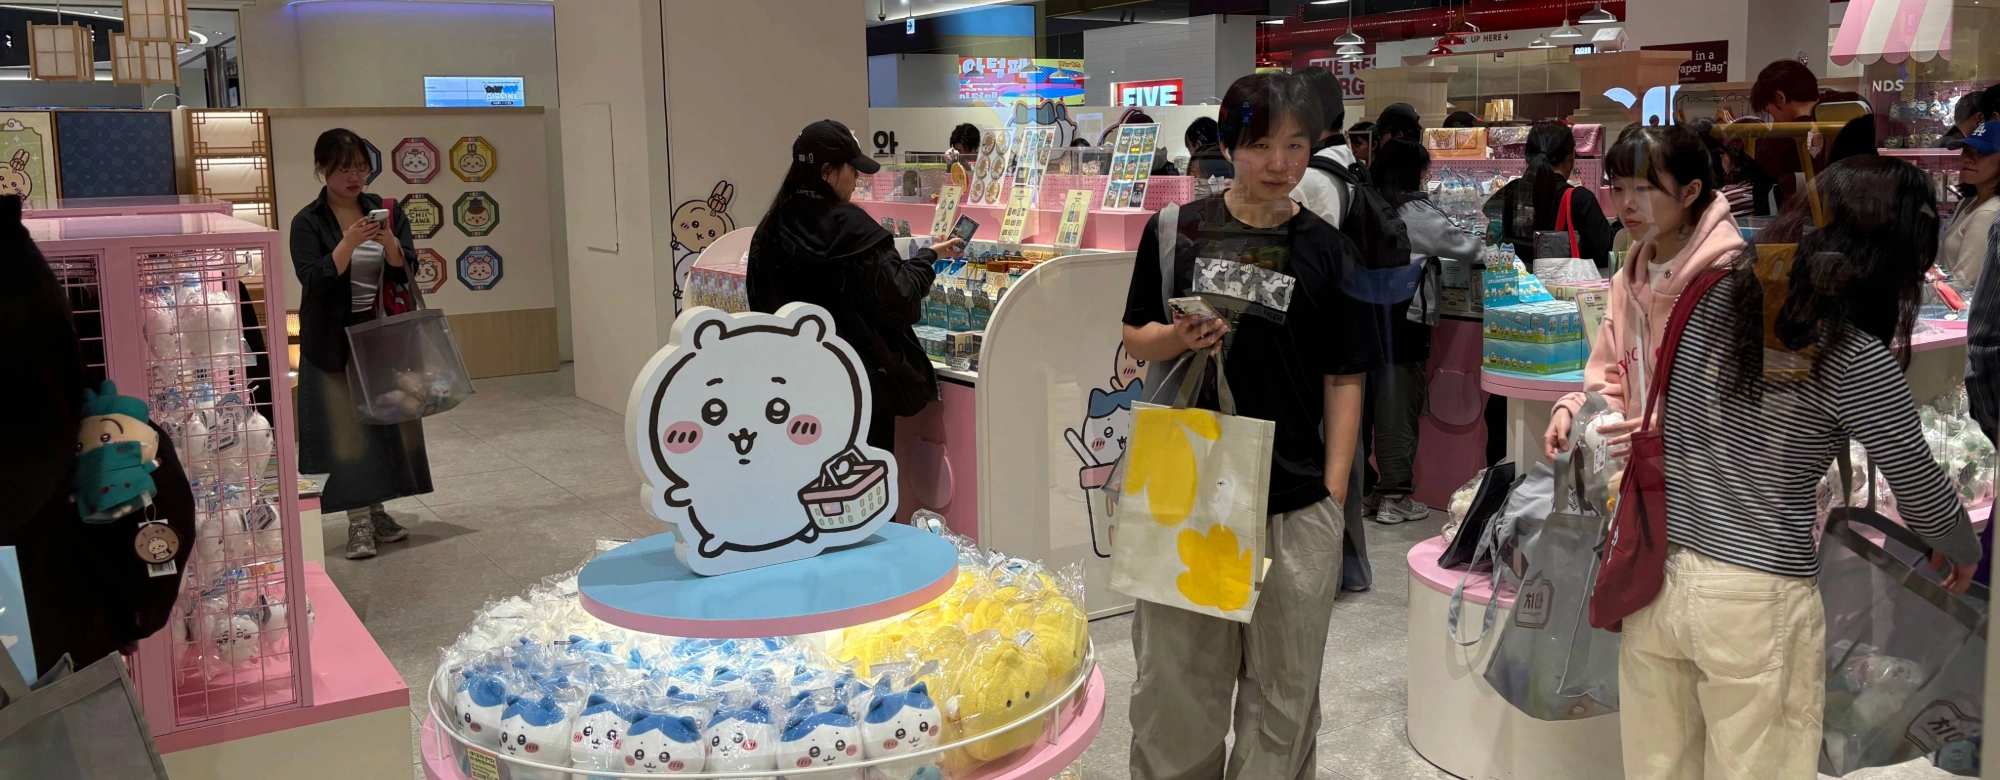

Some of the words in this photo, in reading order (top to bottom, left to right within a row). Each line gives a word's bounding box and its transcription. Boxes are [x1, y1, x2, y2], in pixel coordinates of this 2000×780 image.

[1483, 34, 1502, 42] HERE
[1695, 51, 1706, 60] in
[1708, 52, 1714, 60] a
[1678, 64, 1701, 75] aper
[486, 93, 519, 101] AIRLINE
[1123, 85, 1178, 107] FIVE
